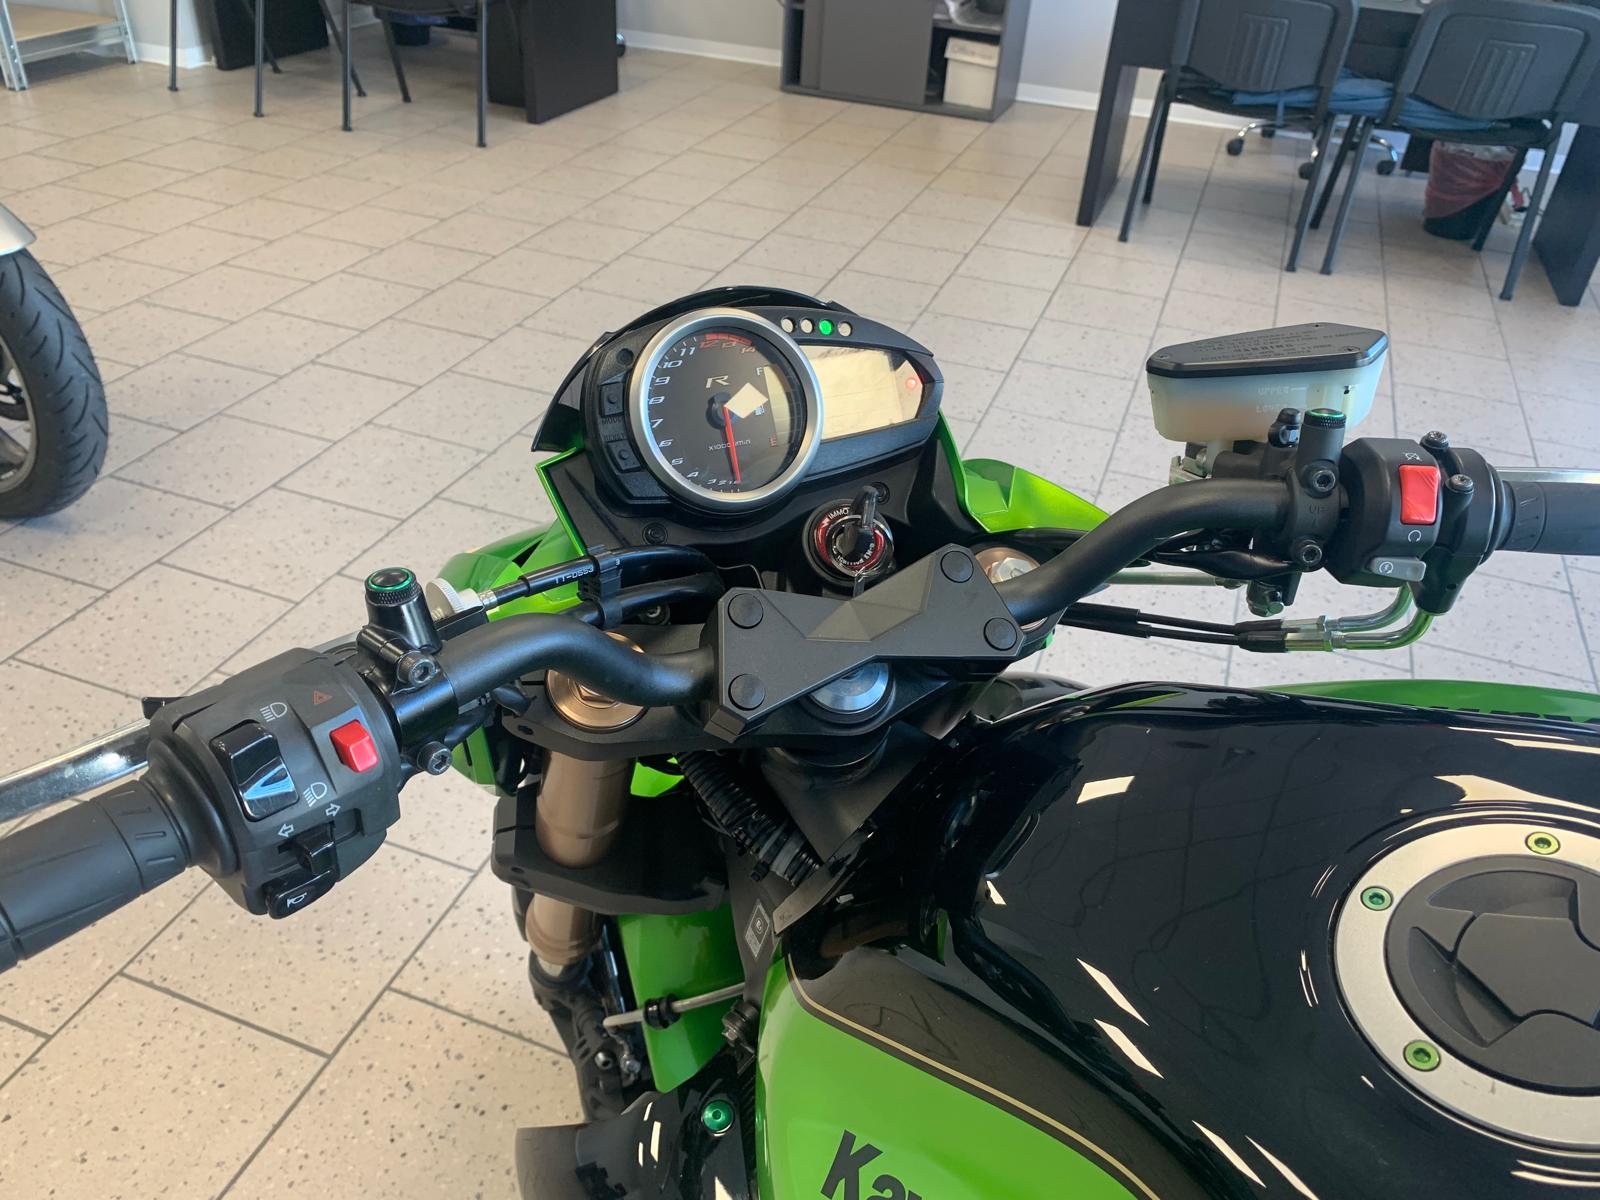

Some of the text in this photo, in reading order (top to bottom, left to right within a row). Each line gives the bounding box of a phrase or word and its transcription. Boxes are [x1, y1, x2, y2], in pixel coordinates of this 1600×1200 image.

[680, 347, 696, 357] 11
[662, 360, 683, 369] 10
[756, 367, 763, 377] F
[653, 376, 671, 386] 9
[705, 375, 730, 389] R
[648, 396, 665, 405] 8
[650, 418, 664, 429] 7
[658, 438, 674, 448] 6
[820, 1128, 923, 1200] Ka
